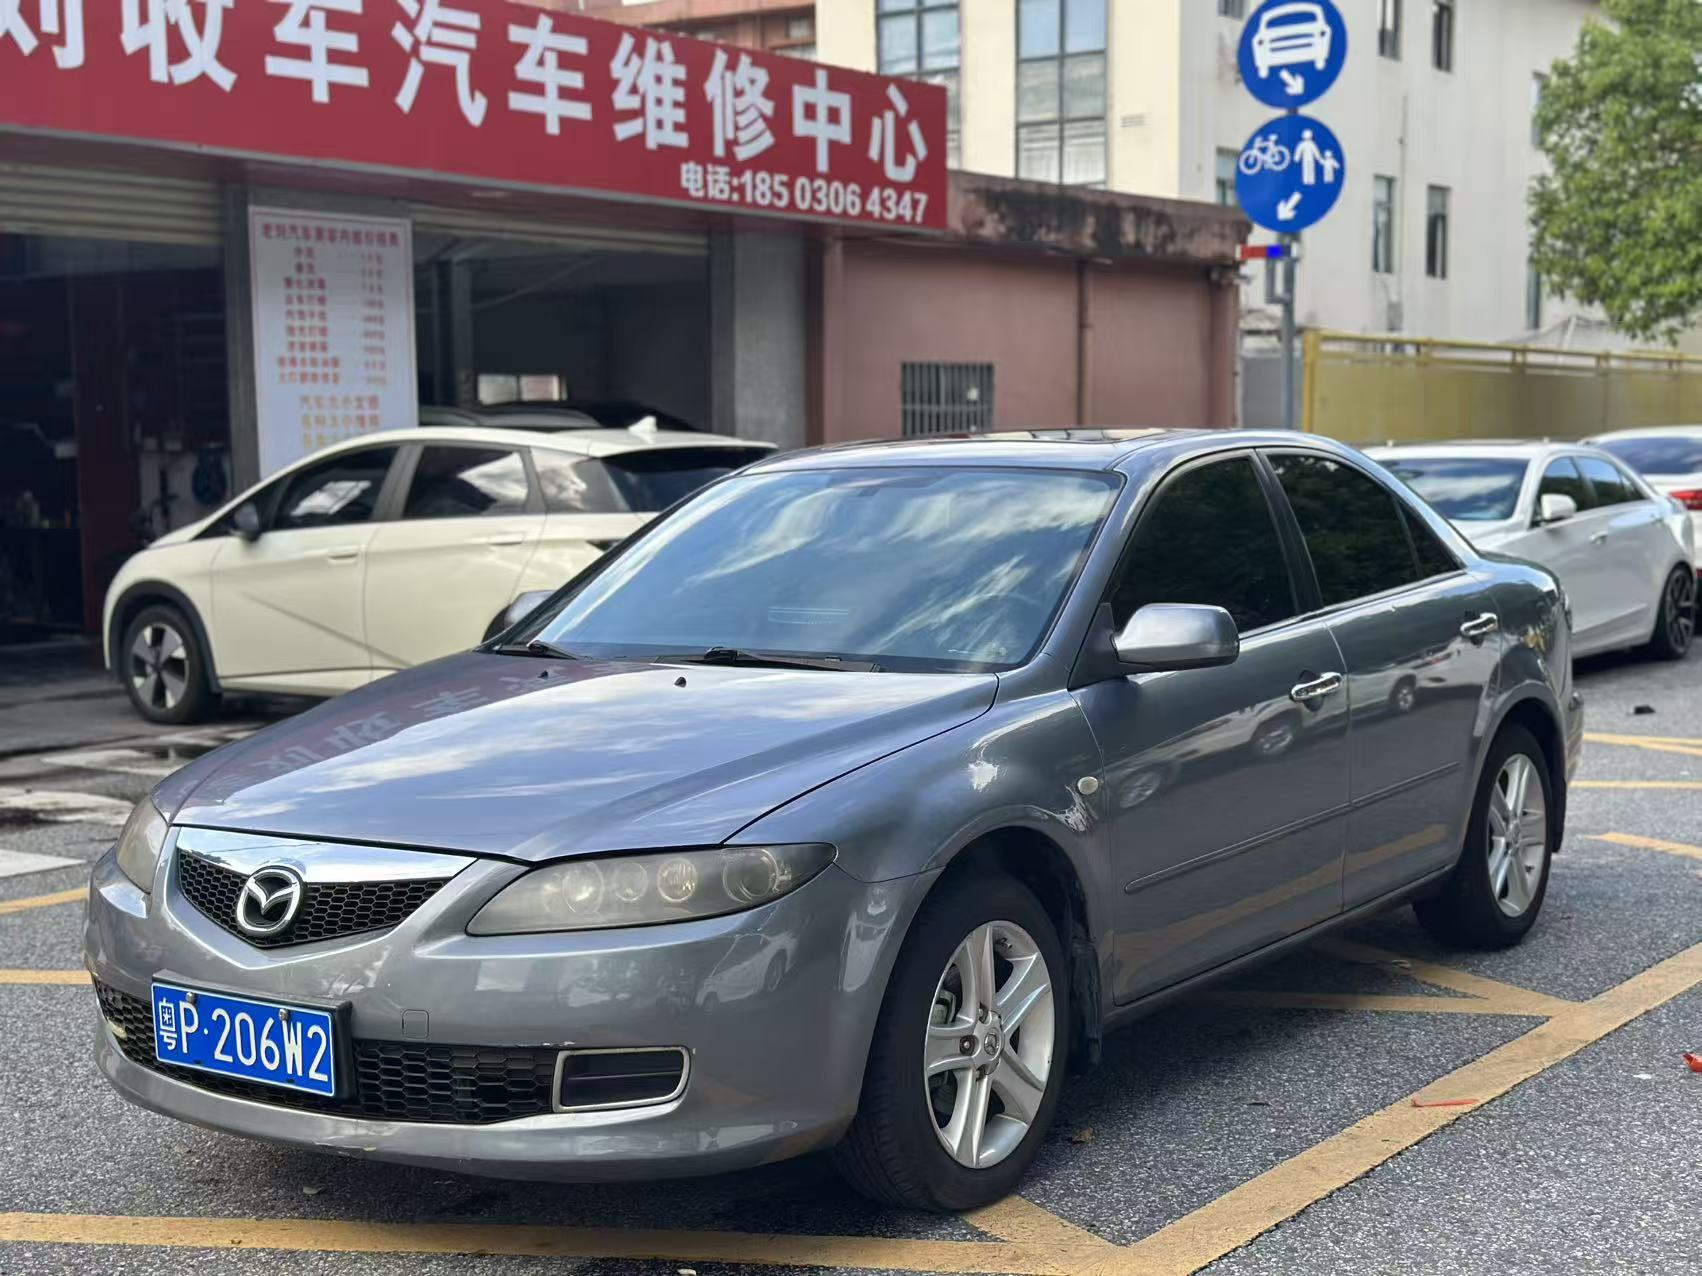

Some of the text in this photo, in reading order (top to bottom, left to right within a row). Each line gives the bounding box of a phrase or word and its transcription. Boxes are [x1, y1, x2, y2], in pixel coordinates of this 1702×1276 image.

[680, 161, 928, 223] 电话:185 0306 4347
